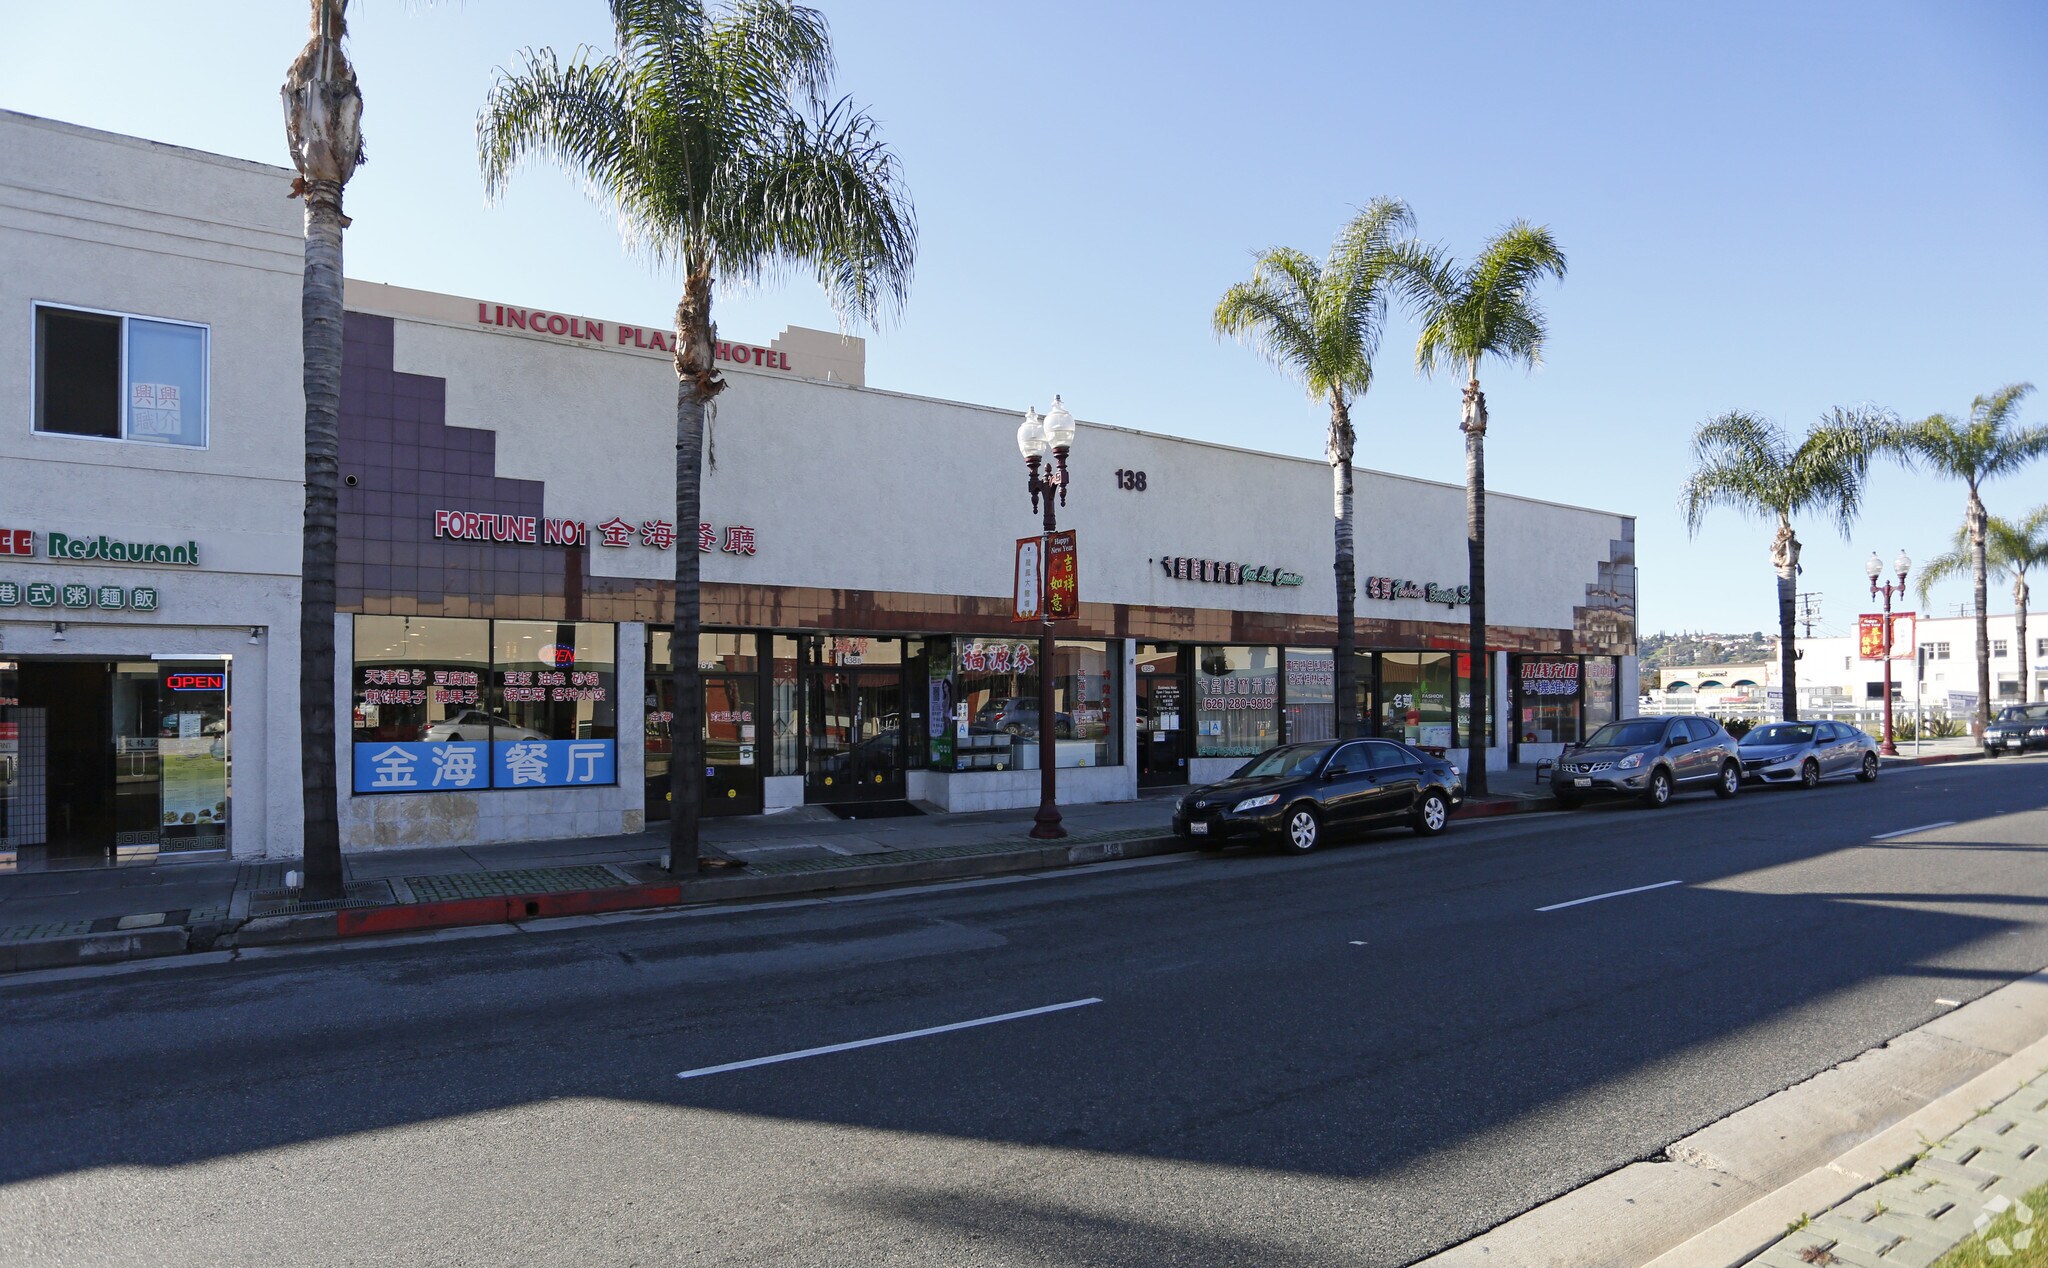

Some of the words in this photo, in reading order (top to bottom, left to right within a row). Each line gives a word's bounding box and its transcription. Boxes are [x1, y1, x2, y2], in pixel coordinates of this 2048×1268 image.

[478, 302, 604, 342] LINCOLN
[618, 325, 677, 352] PLA
[716, 342, 792, 370] HOTEL
[1115, 468, 1147, 492] 138
[434, 509, 537, 543] FORTUNE
[544, 516, 586, 546] NO1
[47, 531, 200, 566] Restaurant
[1051, 546, 1062, 554] New
[1062, 544, 1073, 552] Year
[1054, 537, 1070, 545] Happy
[1063, 553, 1075, 593] 吉祥
[1050, 575, 1062, 611] 如意
[167, 676, 222, 689] OPEN
[365, 669, 427, 686] 天津包子
[433, 670, 479, 687] 豆腐脑
[503, 671, 533, 686] 豆浆
[537, 671, 567, 686] 油条
[571, 671, 600, 687] 砂锅
[503, 687, 546, 702] 锅巴菜
[551, 686, 606, 702] 各种水饺
[1522, 679, 1579, 696] 手機維修
[365, 688, 427, 705] 煎饼果子
[435, 688, 479, 705] 糖果子
[1201, 697, 1226, 711] (626)
[1228, 697, 1273, 711] 280-9818
[648, 710, 674, 723] 金海
[371, 743, 606, 787] 金海餐厅
